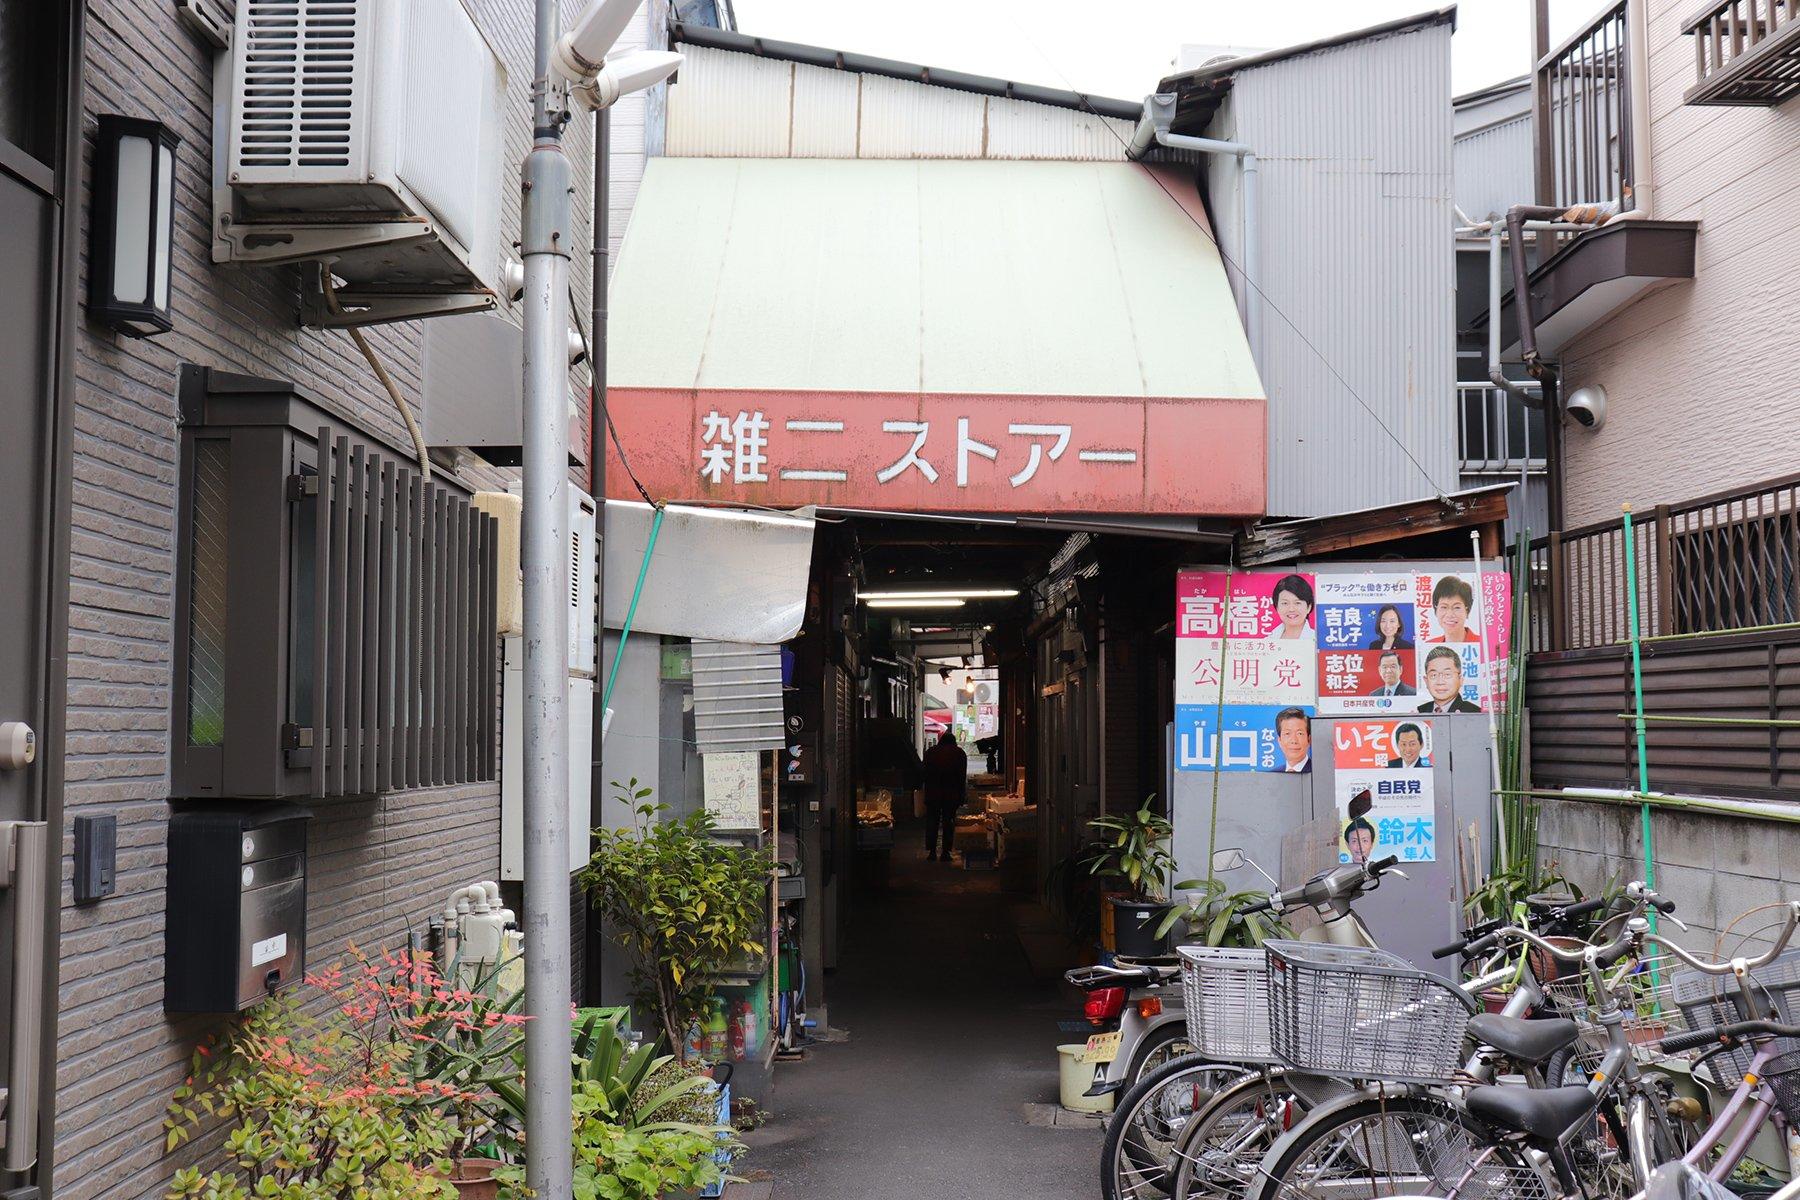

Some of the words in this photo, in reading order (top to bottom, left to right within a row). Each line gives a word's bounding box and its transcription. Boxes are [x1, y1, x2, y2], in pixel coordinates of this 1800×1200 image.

[1180, 595, 1259, 635] 高橋
[1260, 596, 1274, 635] かよこ
[1324, 607, 1362, 626] 吉良
[1325, 627, 1362, 643] よし子
[1192, 659, 1301, 688] 公明党
[1326, 654, 1364, 673] 志位
[1326, 674, 1359, 690] 和夫
[1181, 727, 1258, 767] 山口
[1261, 727, 1275, 768] なつお
[1336, 725, 1389, 751] いそ
[1378, 780, 1422, 795] 自民党
[1378, 818, 1433, 846] 鈴木
[1404, 847, 1432, 861] 隼人
